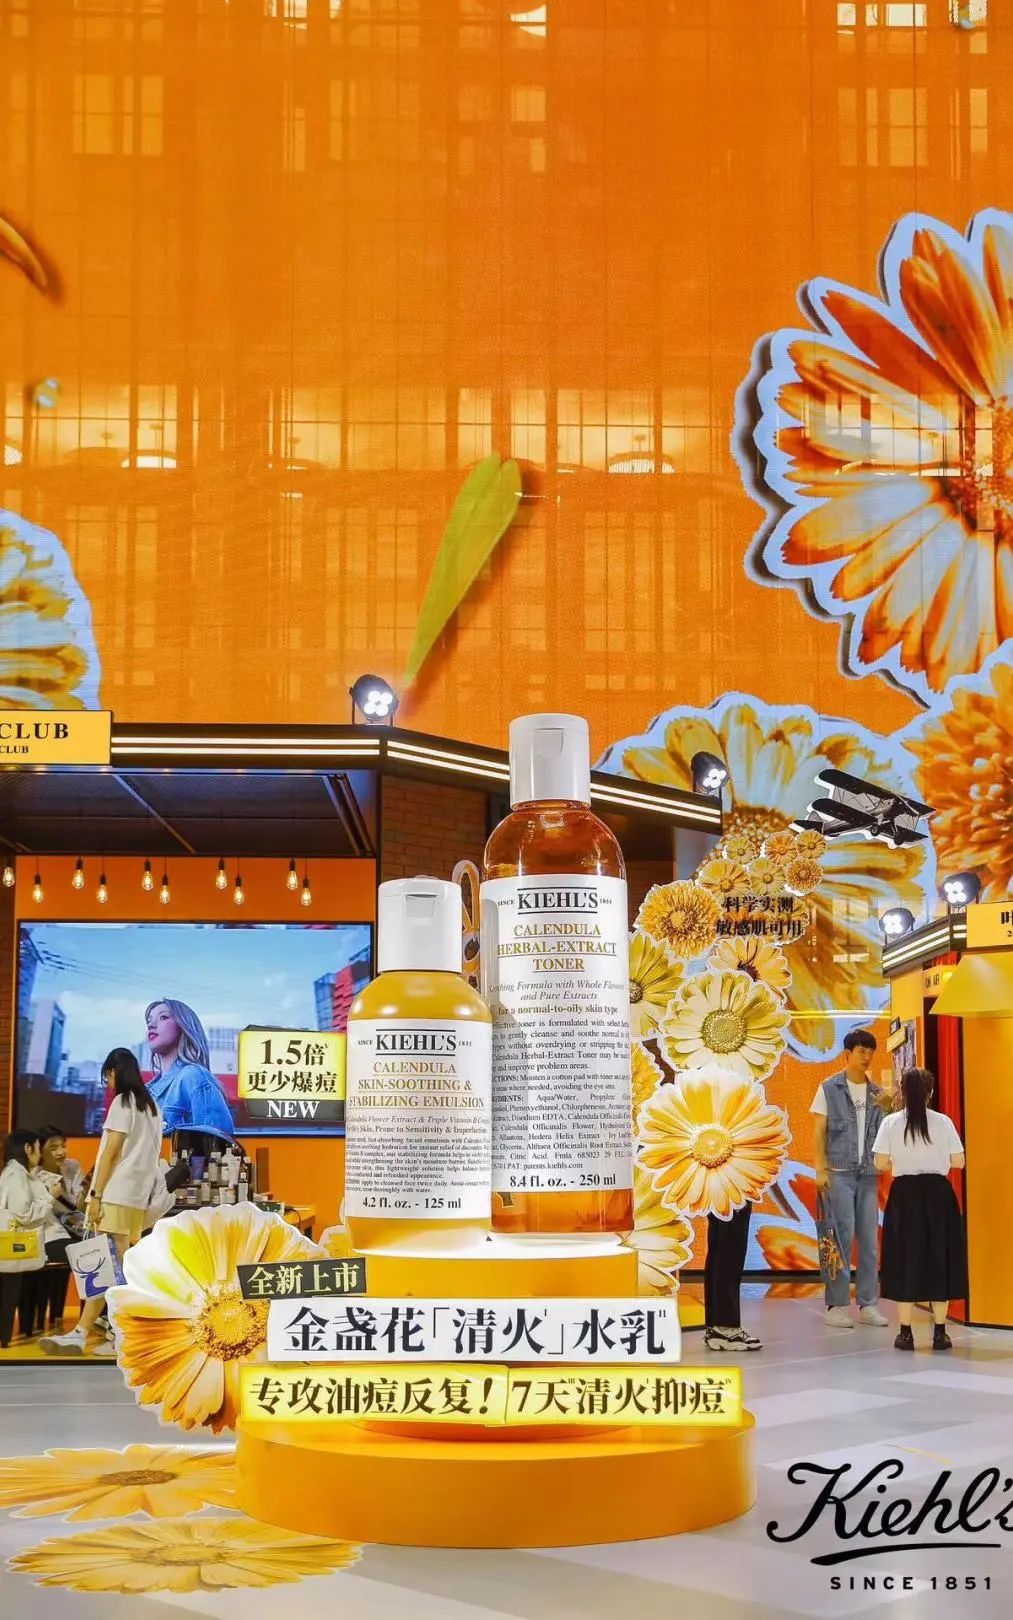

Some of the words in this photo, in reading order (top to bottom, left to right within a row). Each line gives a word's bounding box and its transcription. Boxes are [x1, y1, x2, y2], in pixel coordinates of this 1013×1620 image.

[0, 722, 69, 739] CLUB
[0, 745, 29, 753] CLUB
[517, 892, 598, 909] KIEHL'S
[721, 895, 794, 913] 科学实测
[514, 923, 601, 936] CALENDULA
[716, 919, 802, 937] 敏感肌可用
[497, 941, 617, 955] HERBAL-EXTRACT
[533, 959, 585, 970] TONER
[516, 980, 554, 991] Formula
[555, 979, 575, 989] with
[576, 980, 602, 989] Whole
[520, 991, 538, 1001] and
[539, 991, 561, 1000] Pure
[563, 991, 598, 1000] Extracts
[518, 1003, 583, 1014] normal-to-oily
[585, 1004, 603, 1012] skin
[604, 1004, 618, 1015] type
[508, 1031, 527, 1041] gently
[376, 1034, 457, 1051] KIEHL'S
[535, 1040, 576, 1050] overdrying
[590, 1042, 616, 1050] stripping
[520, 1051, 575, 1060] Herbal-Extract
[577, 1050, 597, 1058] Toner
[600, 1052, 612, 1060] may
[373, 1062, 457, 1073] CALENDULA
[508, 1065, 535, 1073] improve
[537, 1061, 568, 1072] problem
[247, 1070, 337, 1093] 更少爆痘
[574, 1073, 586, 1081] pad
[358, 1079, 461, 1091] SKIN-SOOTHING
[463, 1080, 473, 1091] &
[554, 1083, 582, 1091] avoiding
[348, 1096, 419, 1108] STABILIZING
[423, 1096, 484, 1108] EMULSION
[536, 1094, 579, 1102] Aqua/Water,
[266, 1100, 320, 1118] NEW
[428, 1115, 448, 1124] Triple
[542, 1113, 567, 1121] EDTA,
[405, 1126, 443, 1135] Sensitivity
[556, 1132, 574, 1140] Helix
[578, 1131, 600, 1140] Extract
[397, 1151, 428, 1159] stabilizing
[510, 1175, 527, 1187] 8.4
[530, 1175, 544, 1187] fl.
[547, 1177, 567, 1187] oz.
[579, 1174, 600, 1186] 250
[603, 1174, 616, 1185] ml
[362, 1197, 376, 1208] 4.2
[379, 1197, 392, 1208] fl.
[394, 1200, 412, 1208] oz.
[425, 1198, 445, 1208] 125
[448, 1198, 461, 1208] ml
[247, 1262, 360, 1296] 全新上市
[766, 1458, 1013, 1543] Kiehl's
[830, 1576, 915, 1590] SINCE
[930, 1576, 991, 1590] 1851
